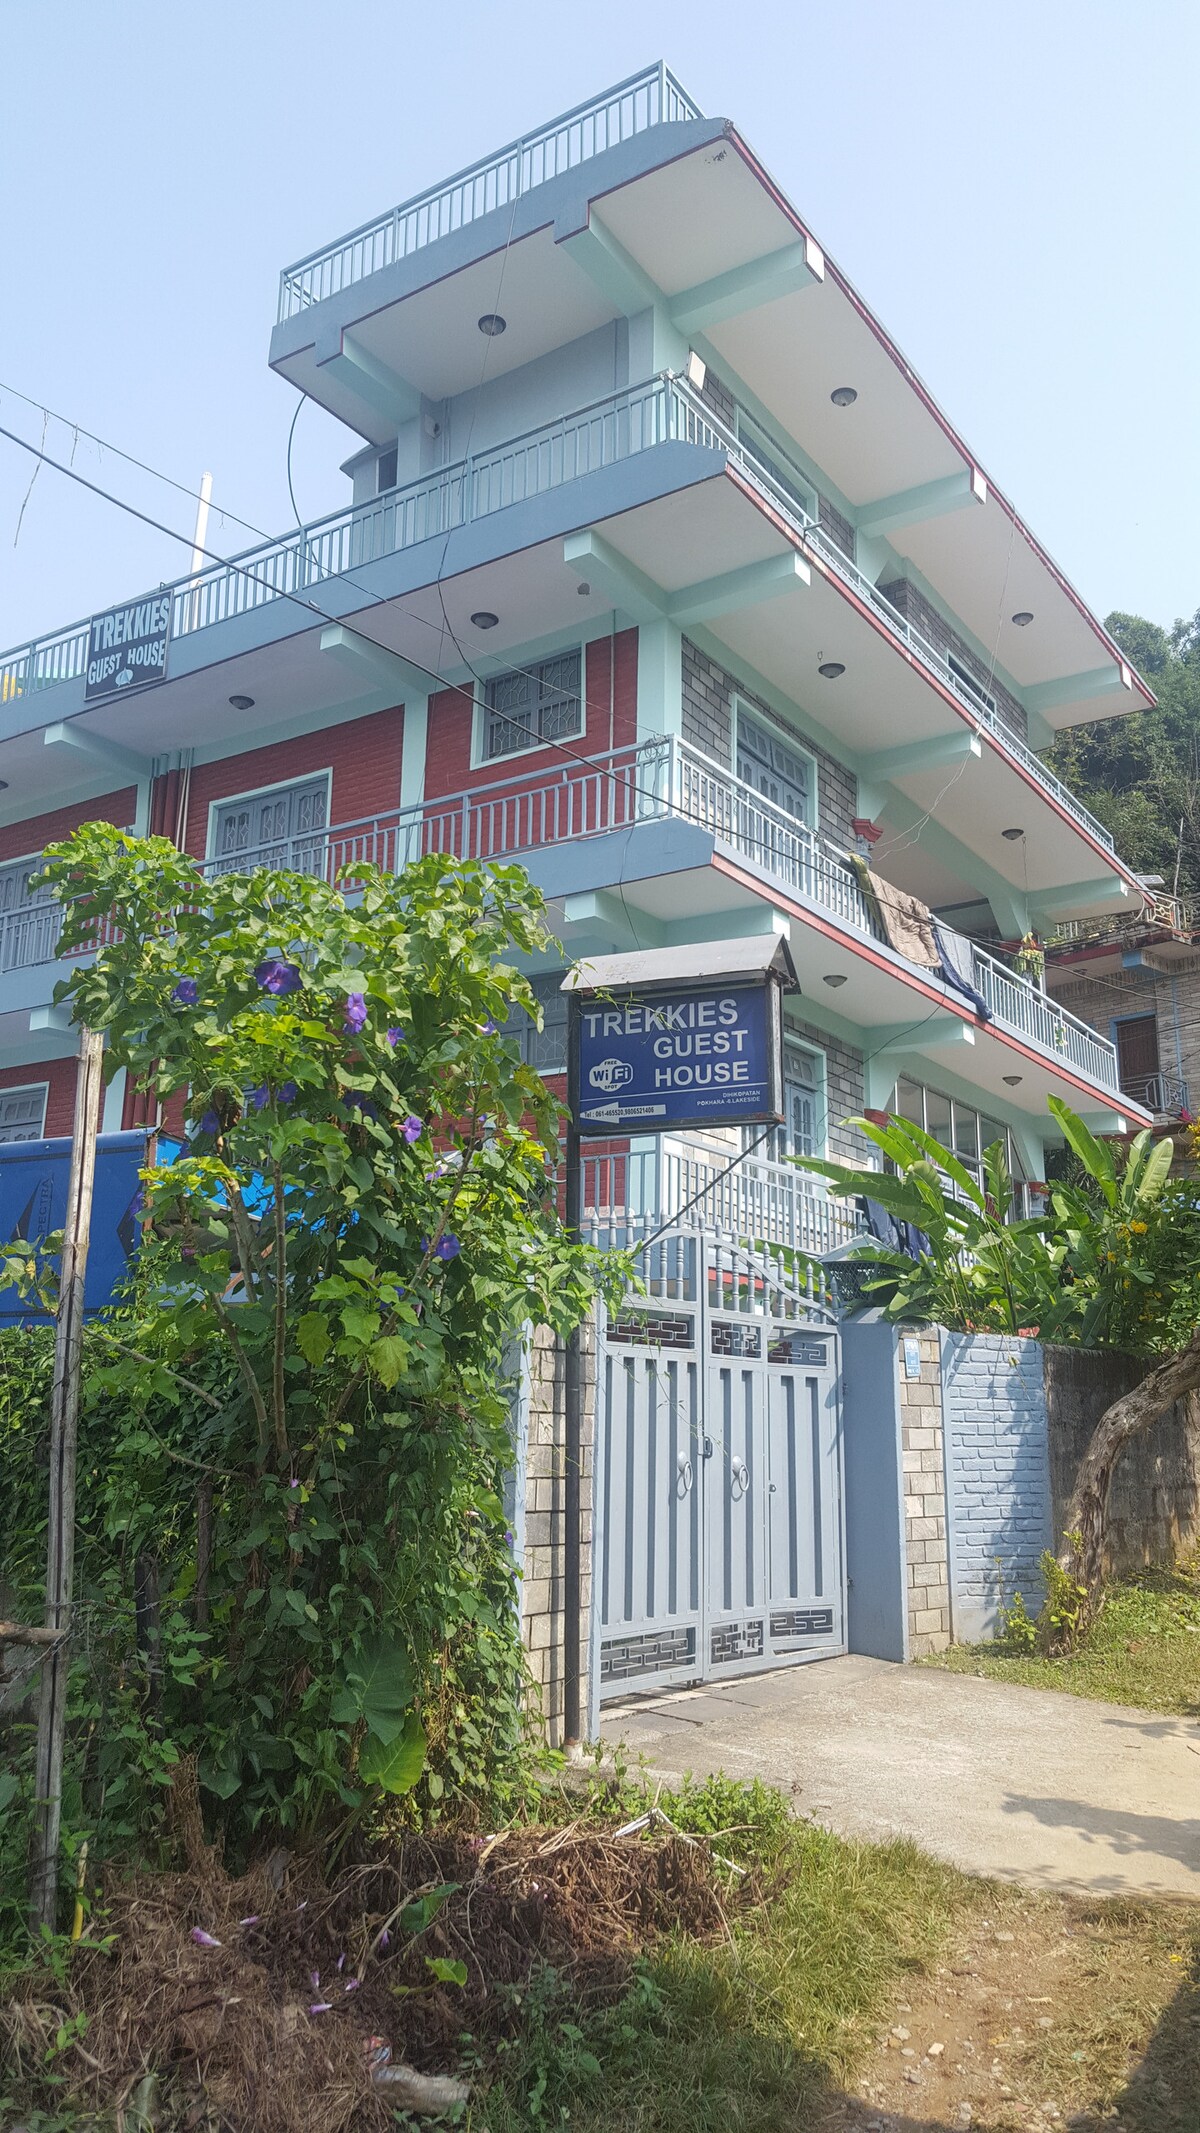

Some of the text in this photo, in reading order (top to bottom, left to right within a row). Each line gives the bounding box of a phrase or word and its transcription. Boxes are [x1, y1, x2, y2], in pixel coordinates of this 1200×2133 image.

[93, 598, 169, 652] TREKKIES
[88, 639, 165, 685] GUEST HOUSE
[584, 999, 738, 1038] TREKKIES
[653, 1030, 748, 1059] GUEST
[655, 1060, 749, 1087] HOUSE
